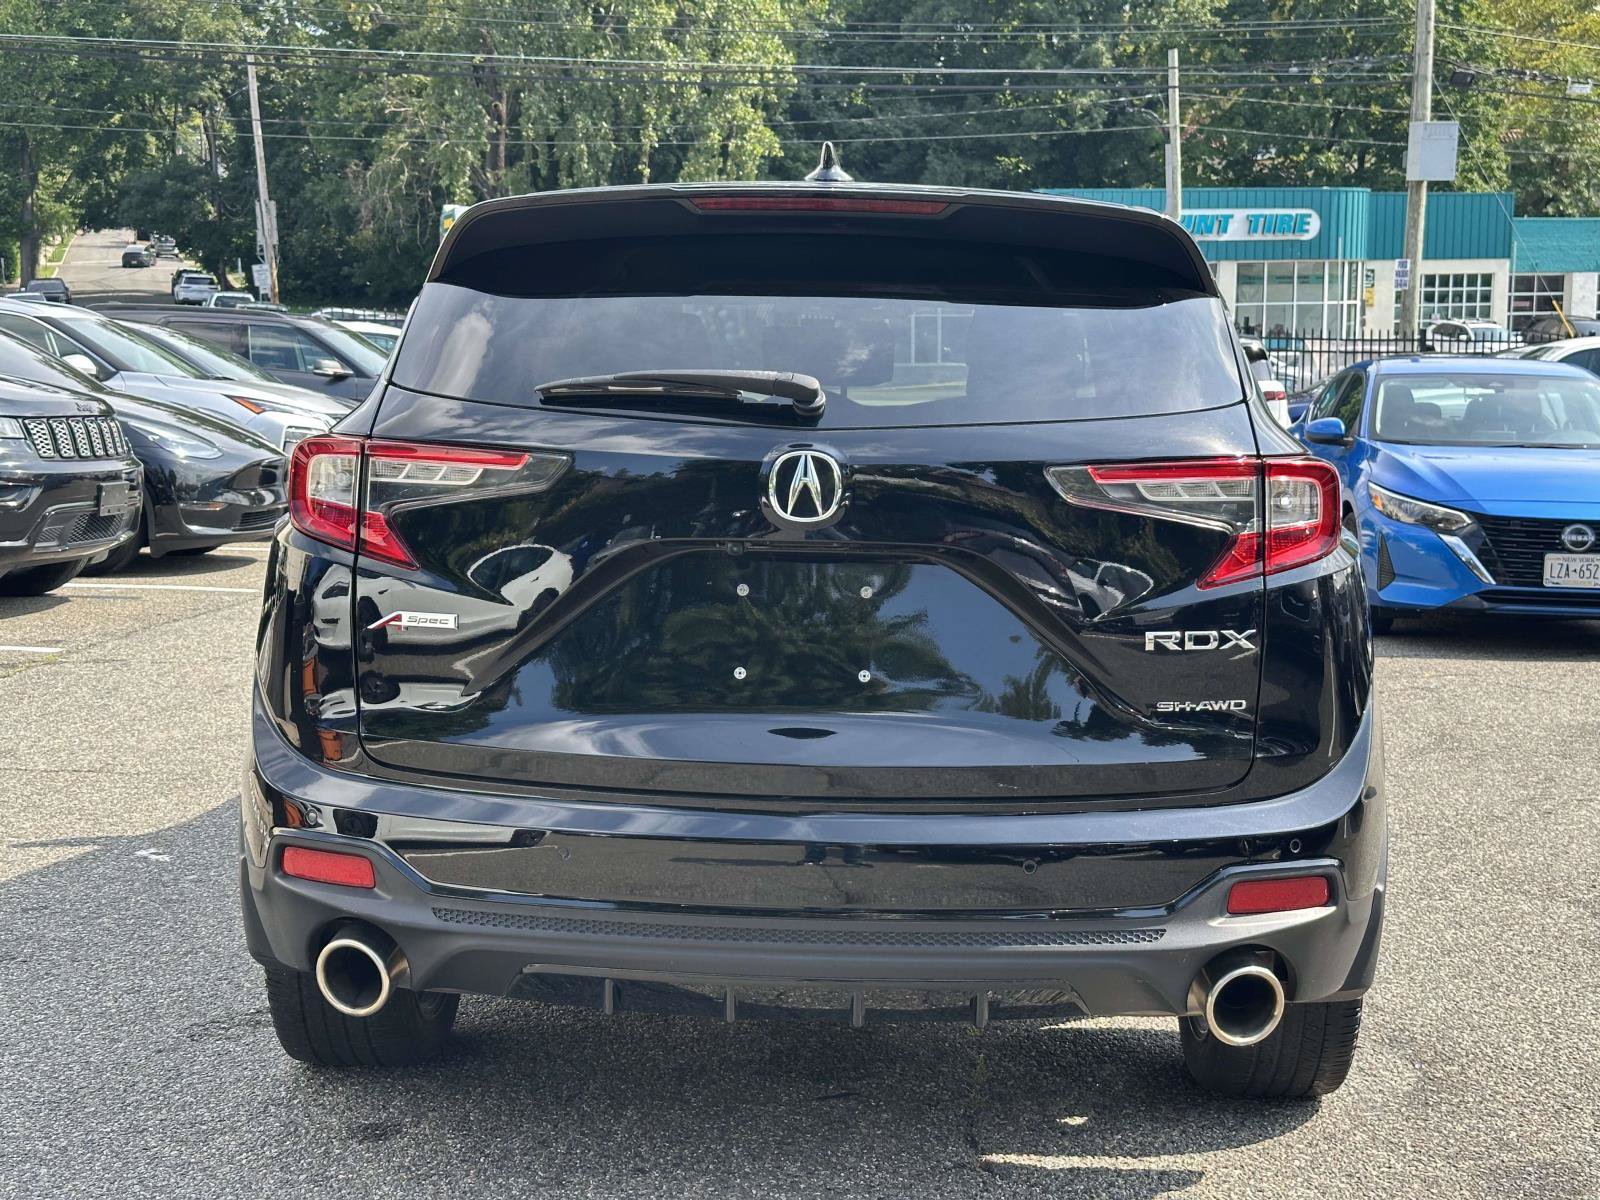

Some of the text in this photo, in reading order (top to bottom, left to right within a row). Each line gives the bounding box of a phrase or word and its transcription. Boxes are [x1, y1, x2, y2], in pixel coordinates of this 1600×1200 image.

[1246, 213, 1312, 236] TIRE
[1144, 629, 1257, 651] RDX
[1156, 699, 1247, 712] SH-AWD
